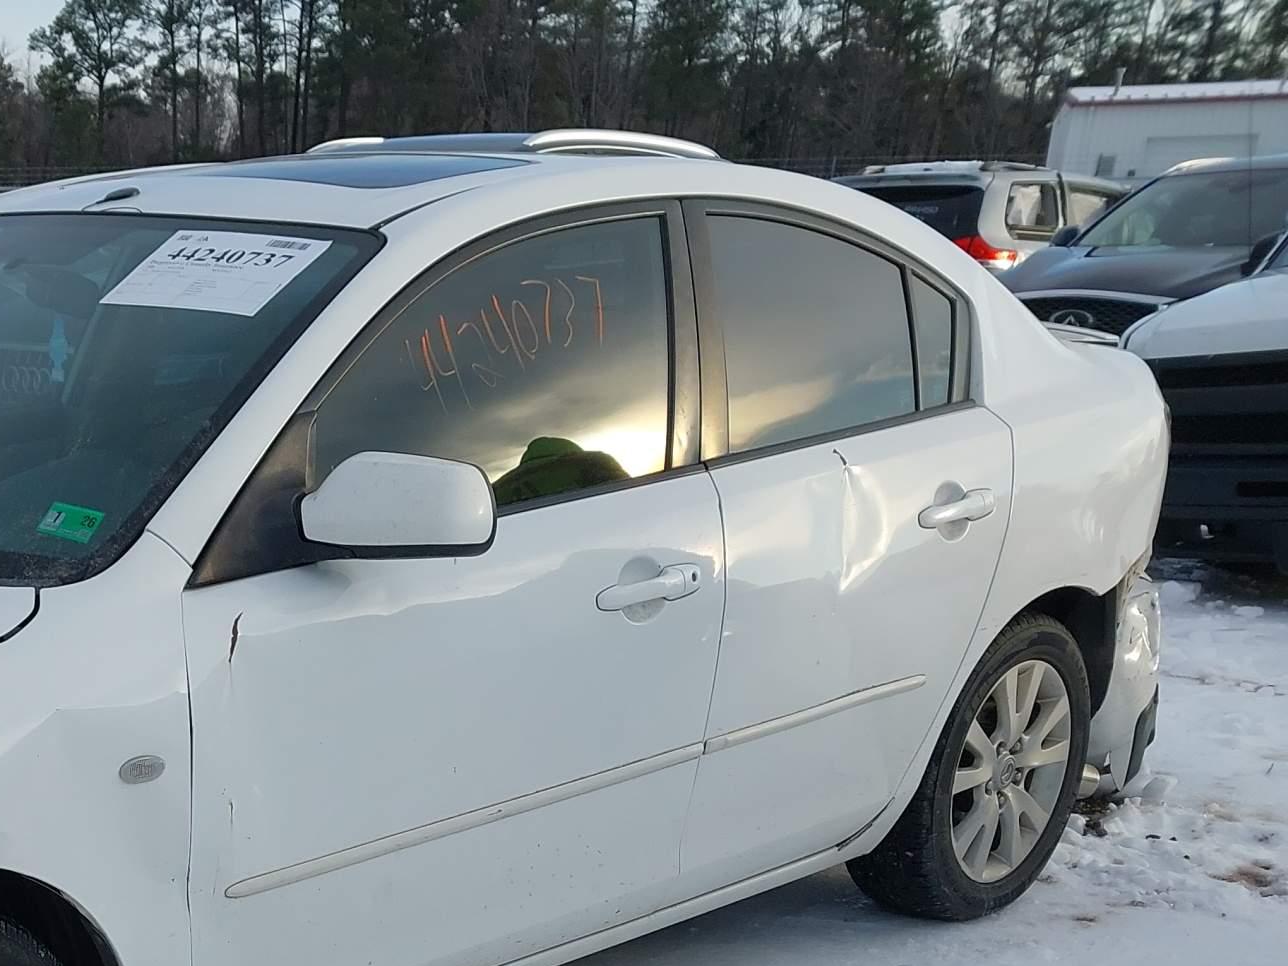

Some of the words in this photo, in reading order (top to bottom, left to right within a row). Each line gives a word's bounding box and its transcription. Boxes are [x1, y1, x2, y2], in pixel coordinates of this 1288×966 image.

[167, 246, 295, 269] 44240737
[403, 276, 605, 415] 44240737
[80, 515, 97, 528] 26
